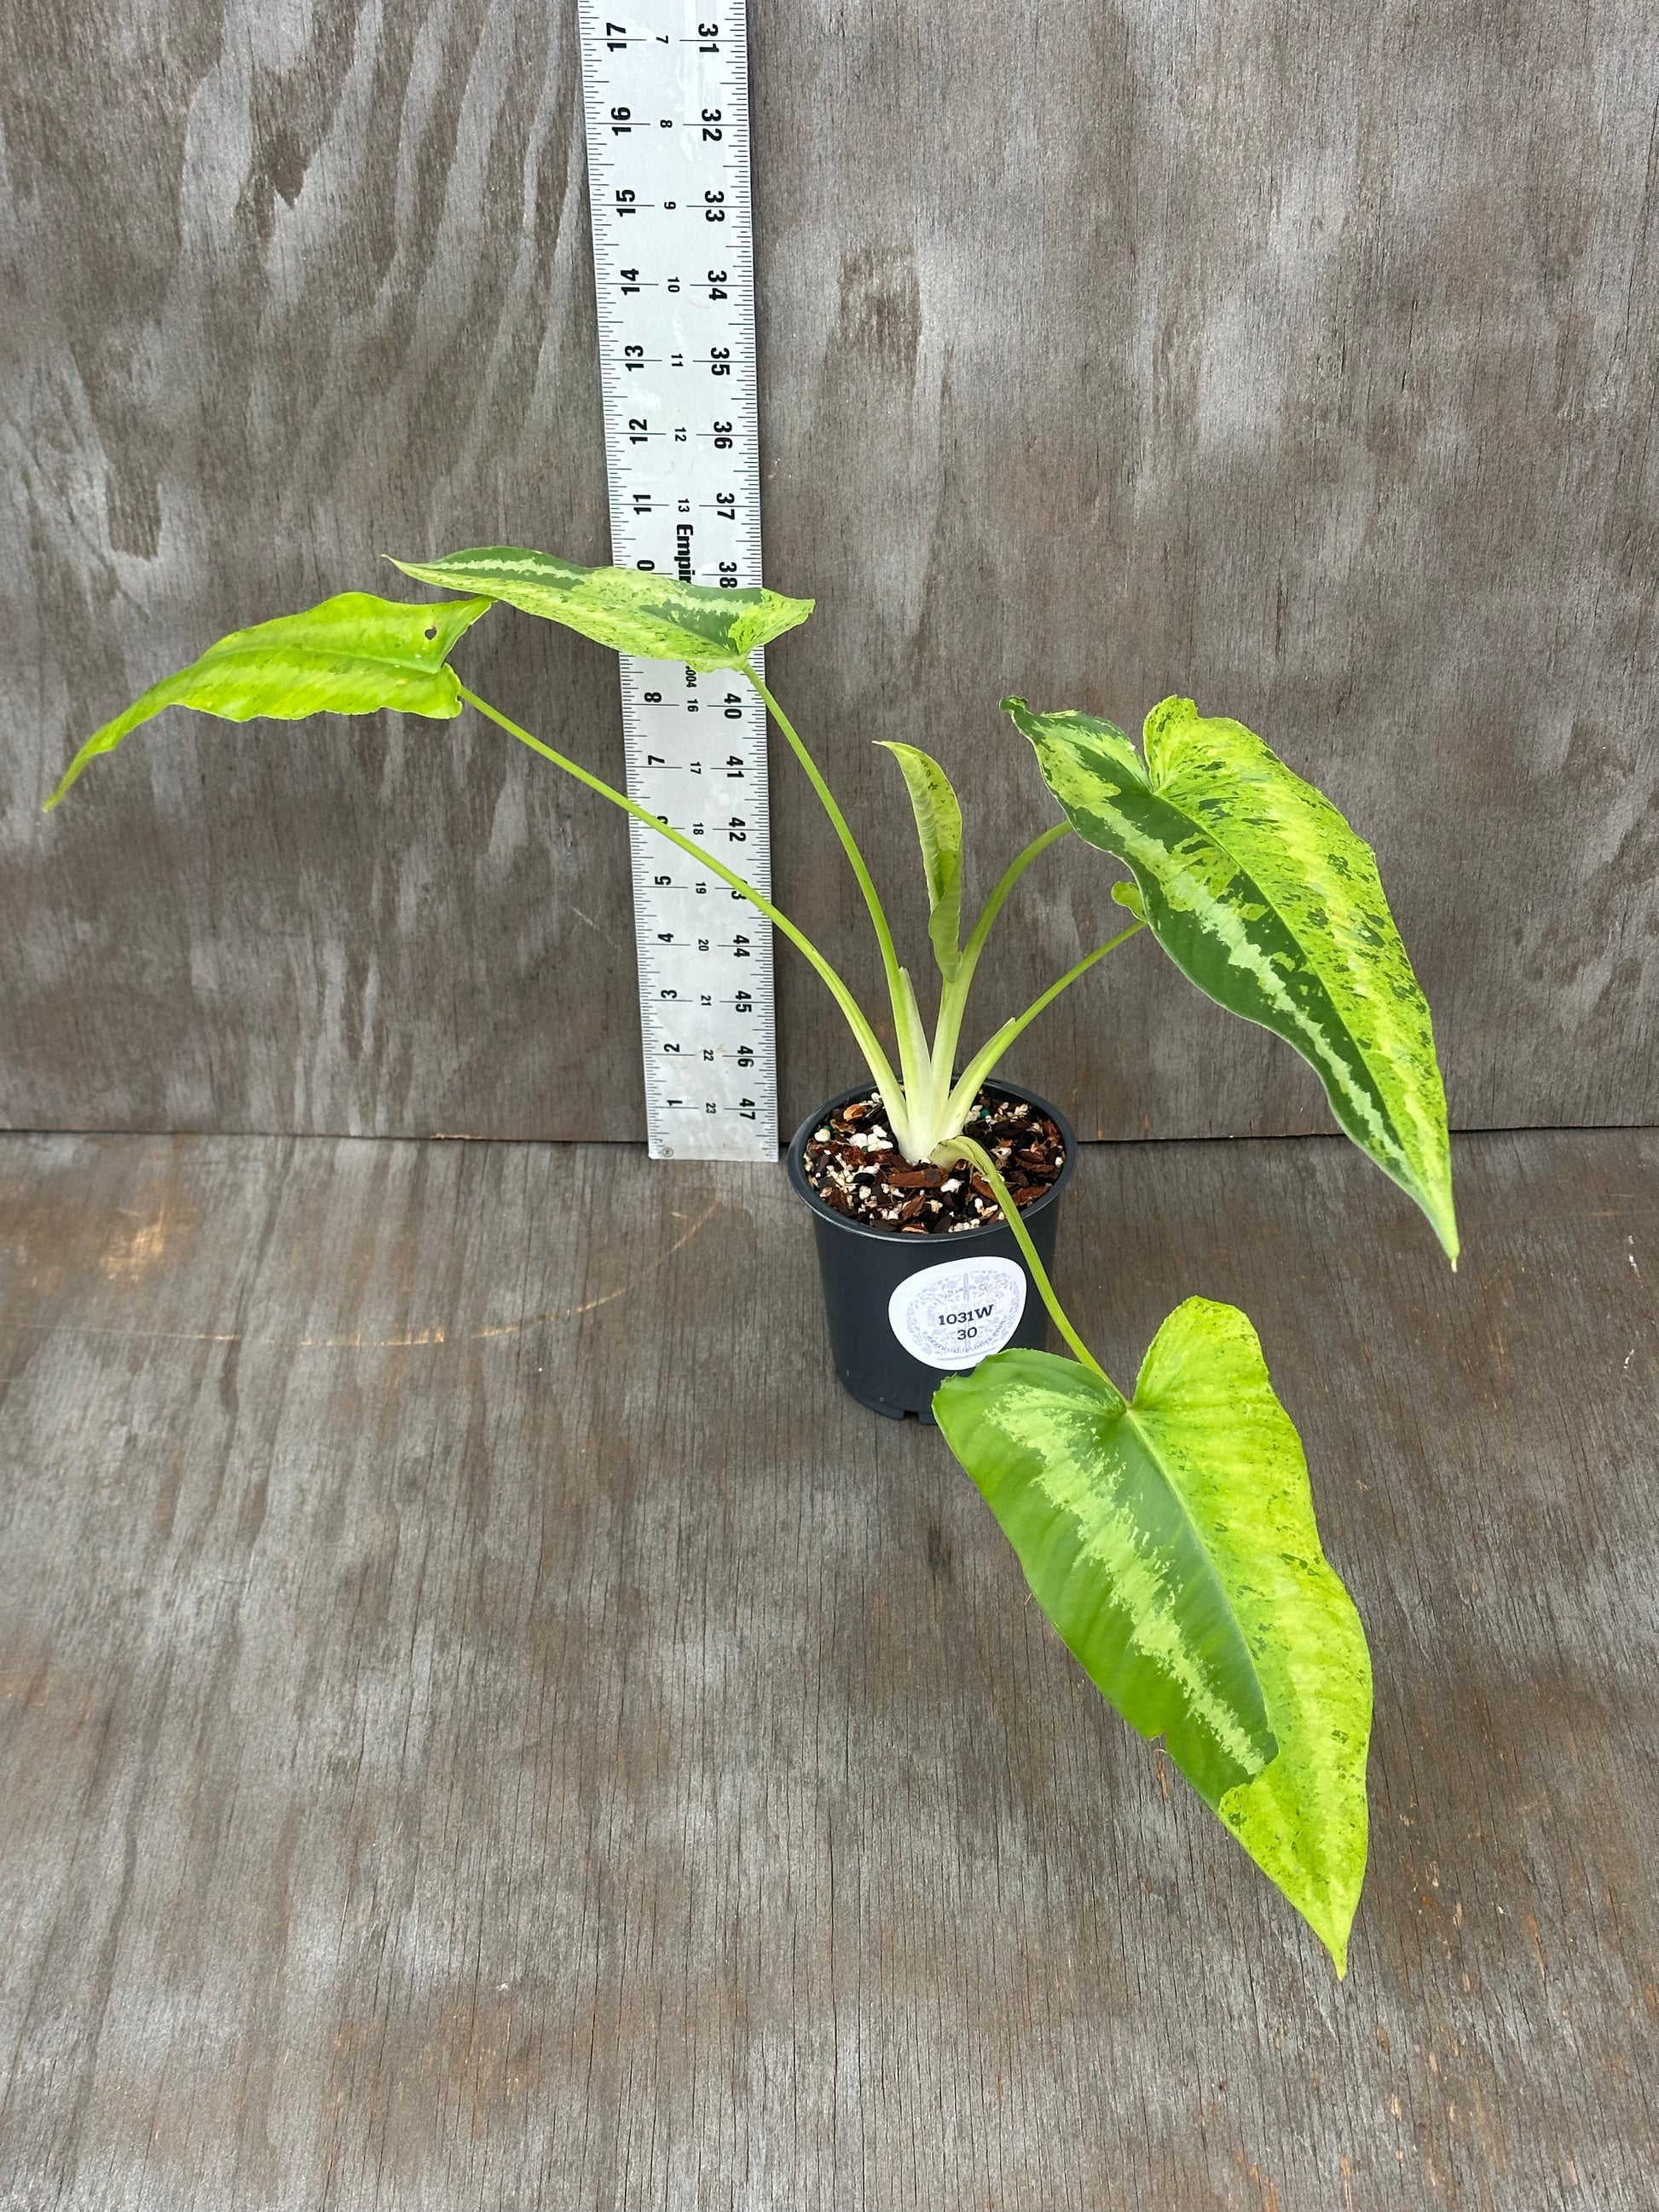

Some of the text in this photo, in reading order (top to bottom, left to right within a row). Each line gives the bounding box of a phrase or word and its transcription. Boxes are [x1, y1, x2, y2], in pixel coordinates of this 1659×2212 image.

[605, 22, 627, 53] 17
[656, 35, 669, 44] 7
[697, 23, 720, 53] 31
[610, 107, 632, 136] 16
[660, 119, 673, 129] 8
[701, 108, 723, 141] 32
[616, 189, 636, 217] 15
[663, 201, 677, 211] 9
[704, 190, 725, 222] 33
[620, 268, 640, 296] 14
[667, 276, 680, 293] 10
[707, 269, 728, 301] 34
[624, 345, 645, 373] 13
[670, 353, 684, 367] 11
[710, 347, 731, 376] 35
[628, 419, 649, 445] 12
[674, 426, 687, 442] 12
[713, 420, 733, 449] 36
[632, 494, 652, 516] 11
[677, 498, 691, 513] 13
[715, 492, 736, 521] 37
[673, 523, 696, 584] Empir
[719, 561, 738, 589] 38
[644, 691, 662, 703] 8
[686, 698, 699, 713] 16
[723, 692, 743, 719] 40
[647, 754, 665, 765] 7
[690, 761, 702, 775] 17
[725, 755, 745, 778] 41
[692, 822, 704, 835] 18
[728, 817, 747, 842] 42
[654, 875, 672, 886] 5
[695, 881, 707, 894] 19
[657, 933, 674, 944] 4
[697, 939, 709, 952] 20
[732, 934, 750, 958] 44
[660, 990, 678, 999] 3
[700, 995, 712, 1006] 21
[735, 990, 753, 1014] 45
[663, 1043, 680, 1053] 2
[702, 1049, 714, 1061] 22
[737, 1045, 754, 1068] 46
[705, 1102, 717, 1114] 23
[738, 1097, 756, 1121] 47
[938, 1304, 994, 1325] 1031W
[957, 1326, 978, 1341] 30
